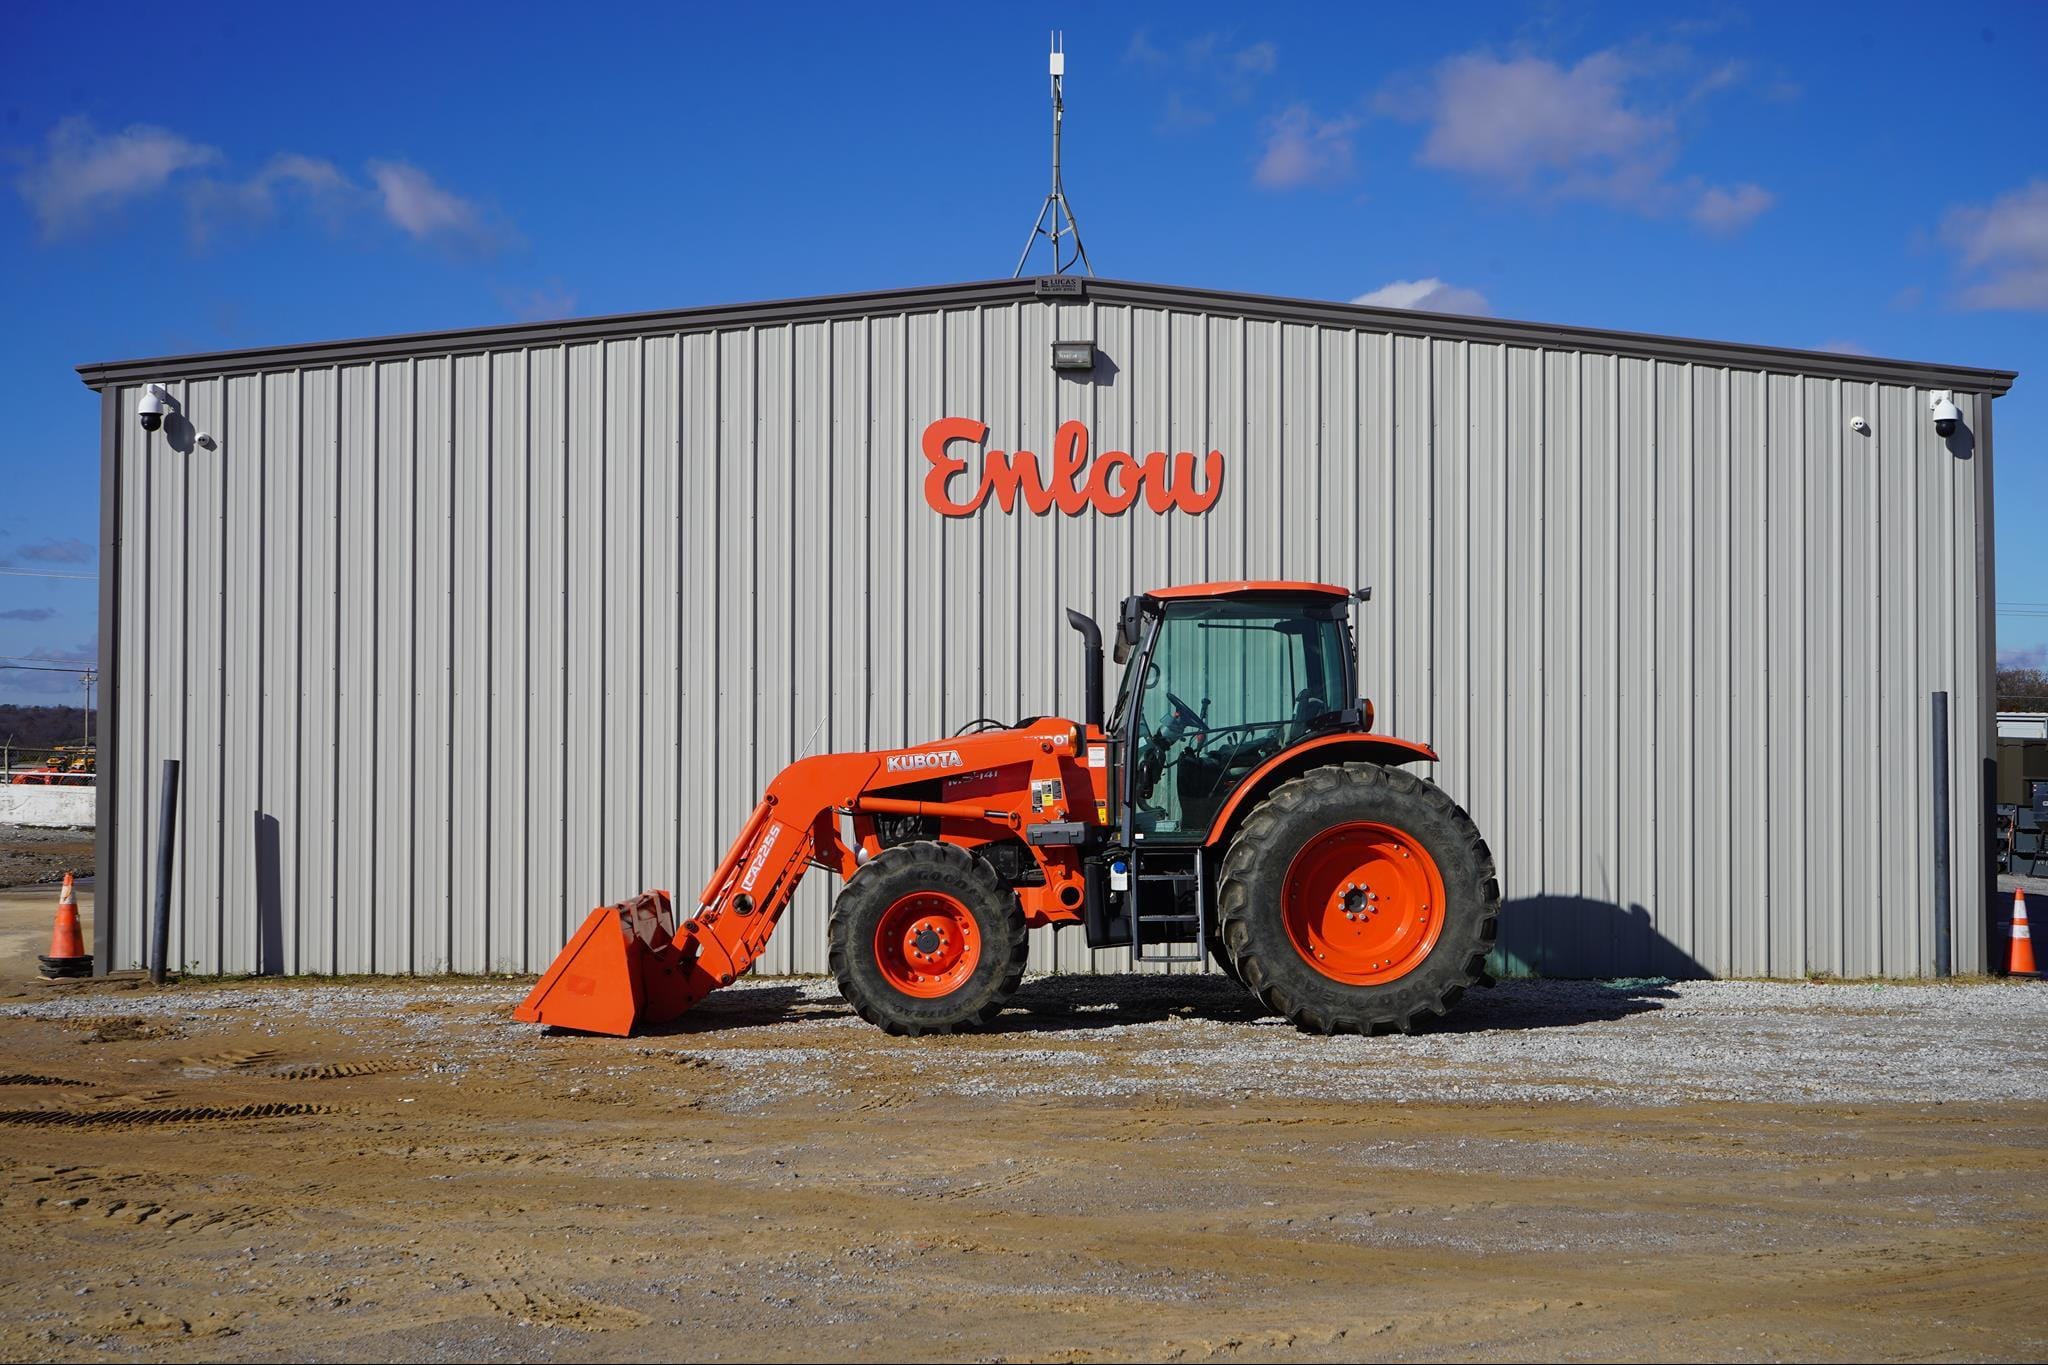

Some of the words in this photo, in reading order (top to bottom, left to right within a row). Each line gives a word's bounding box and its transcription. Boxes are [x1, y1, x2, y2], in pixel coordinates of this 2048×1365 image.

[922, 417, 1223, 515] Enlow
[887, 750, 963, 772] KUBOTA
[741, 824, 781, 892] LA2255
